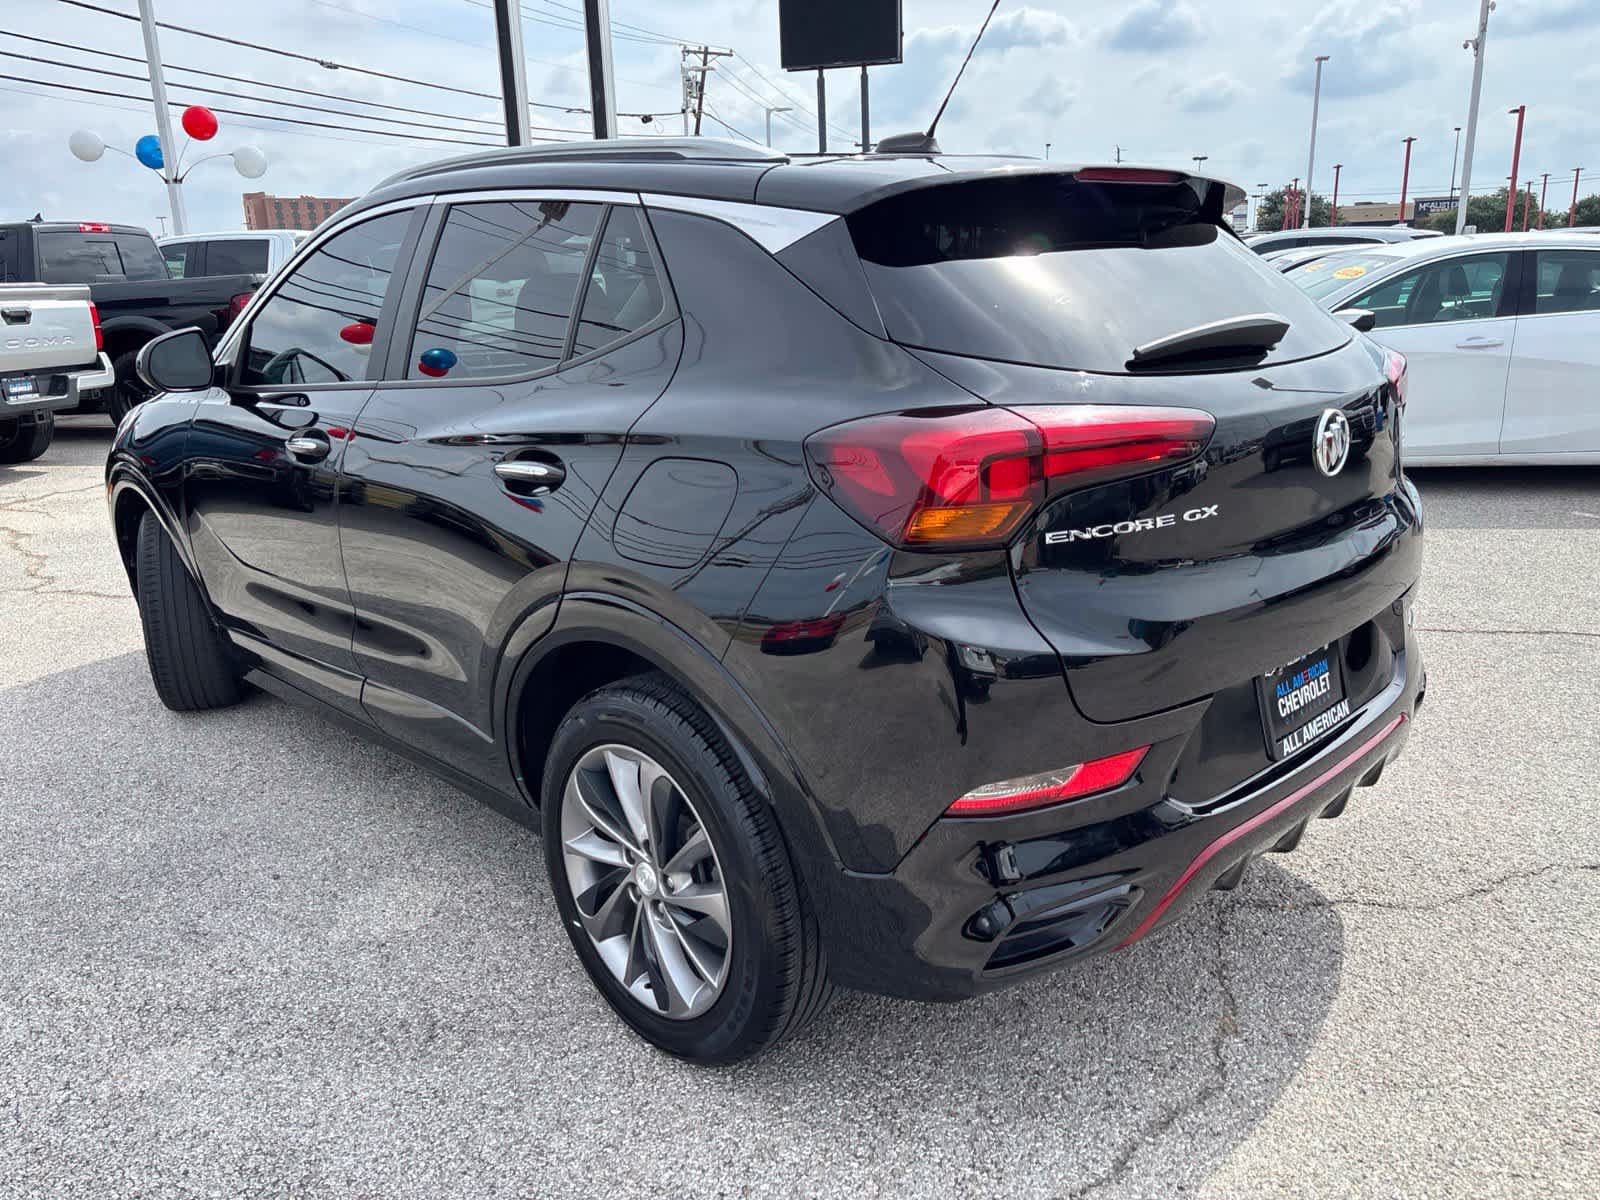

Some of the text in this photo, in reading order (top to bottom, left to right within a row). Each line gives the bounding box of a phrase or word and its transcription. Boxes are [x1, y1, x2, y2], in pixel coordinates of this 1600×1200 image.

[5, 335, 75, 349] COMA
[1045, 504, 1219, 545] ENCORE GX
[1276, 680, 1293, 698] ALL
[1293, 659, 1329, 687] AMERICAN
[1278, 672, 1331, 718] CHEVROLET
[1283, 731, 1303, 757] ALL
[1302, 698, 1350, 744] AMERICAN
